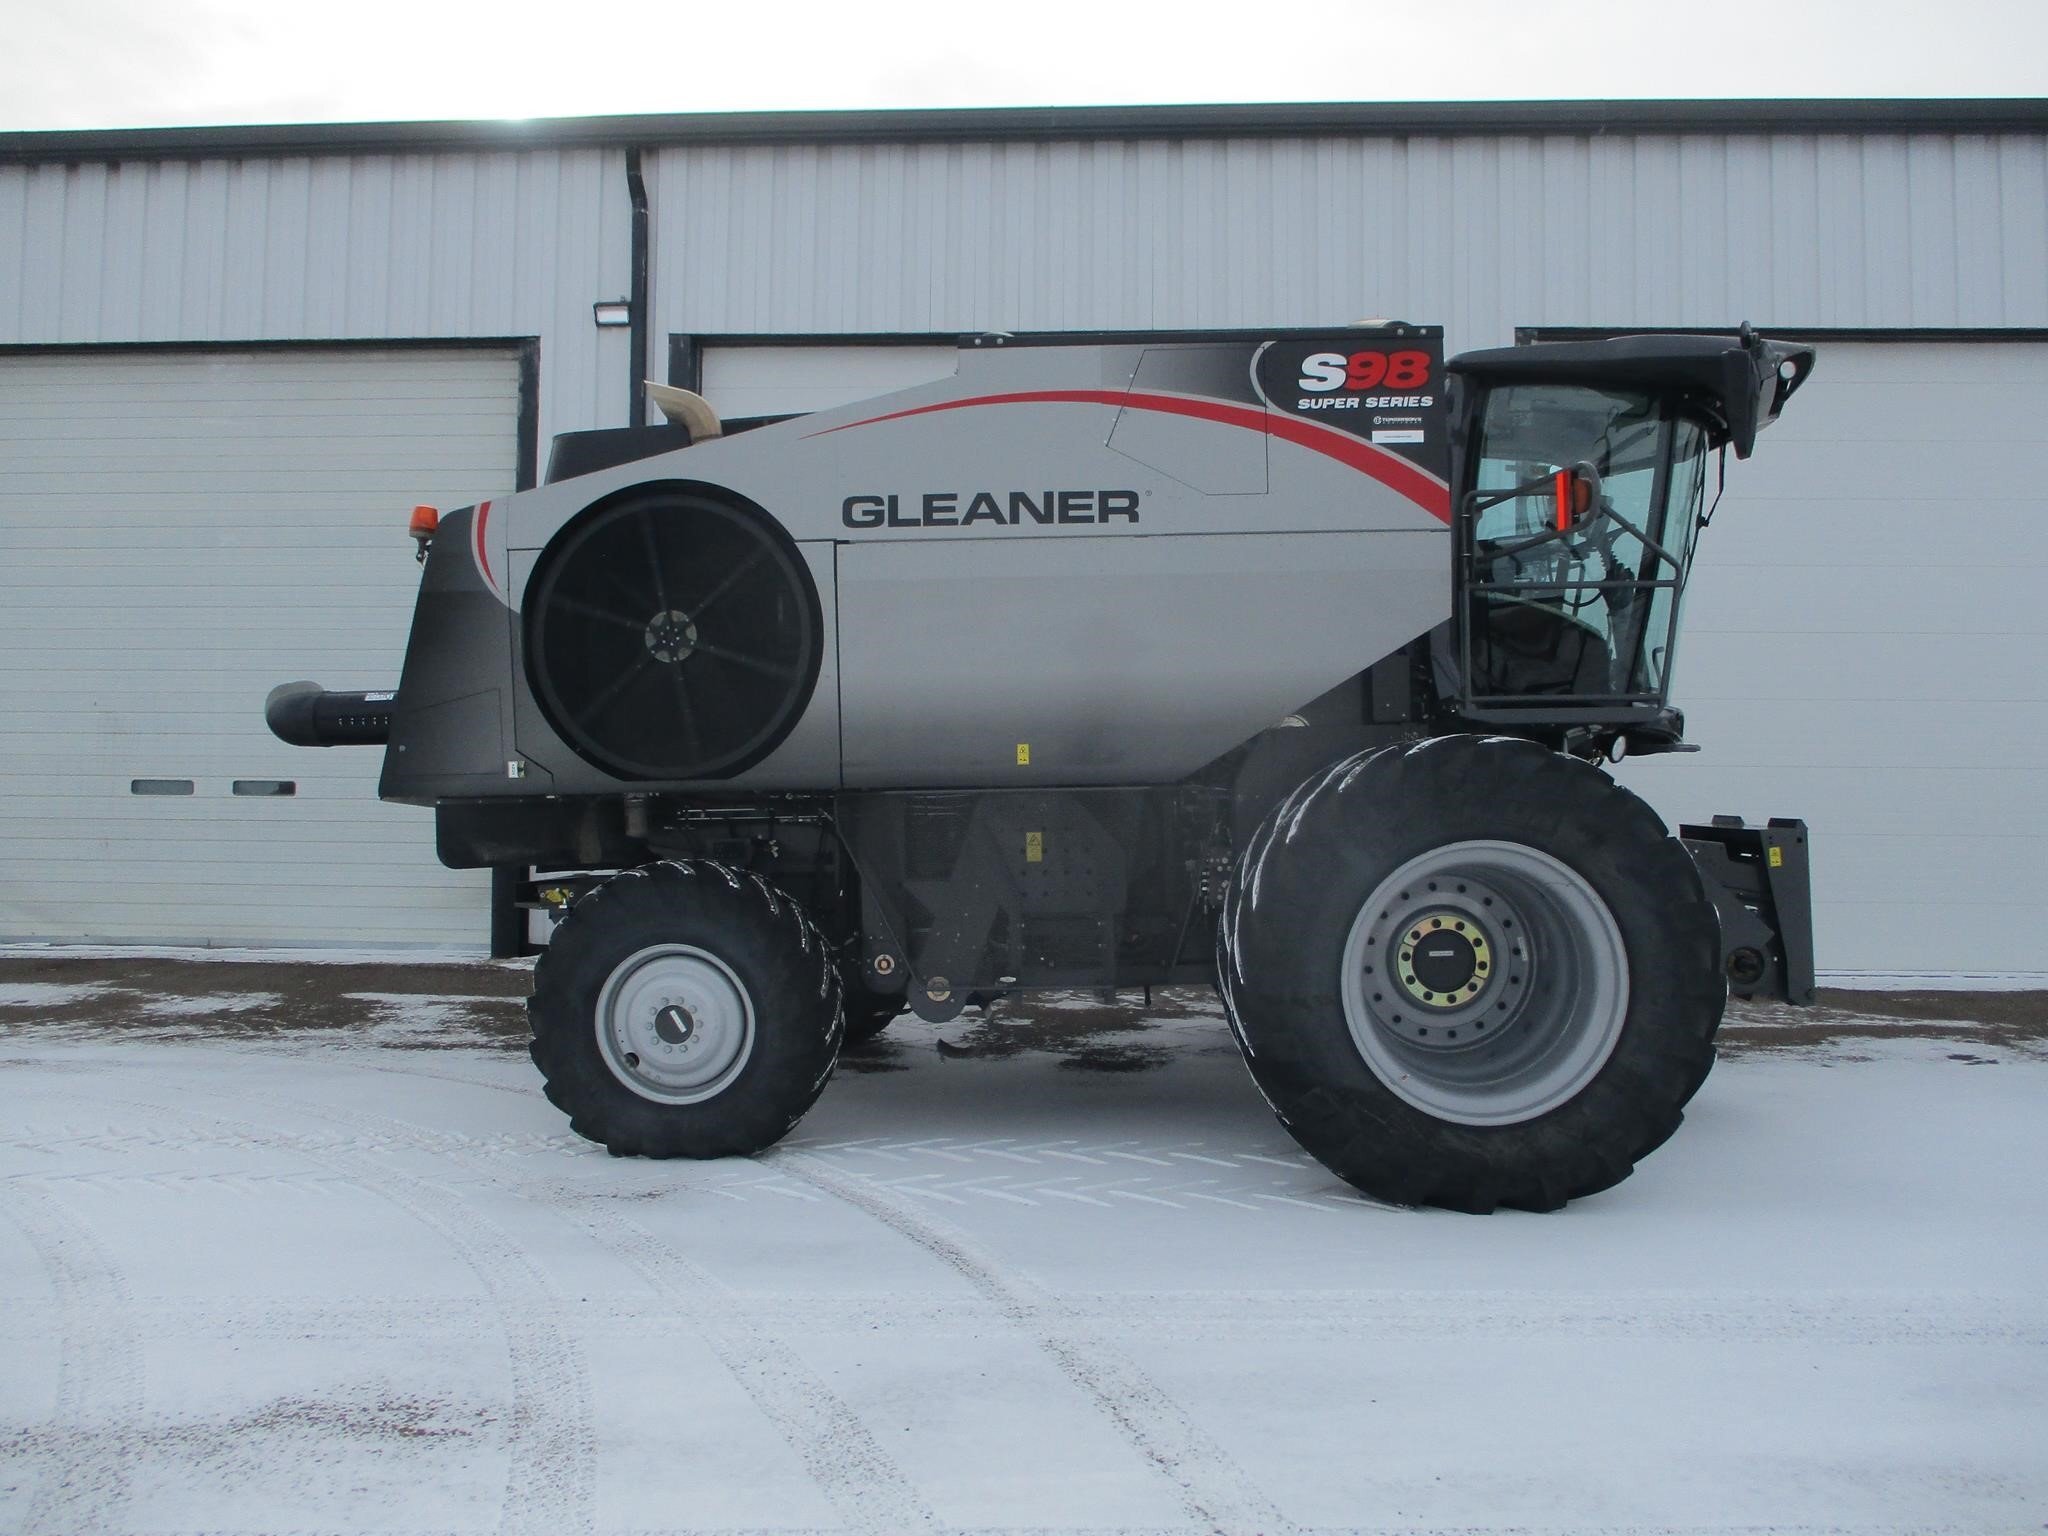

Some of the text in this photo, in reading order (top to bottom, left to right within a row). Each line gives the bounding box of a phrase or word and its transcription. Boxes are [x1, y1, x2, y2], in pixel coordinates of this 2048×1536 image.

[1298, 351, 1432, 392] S98
[1297, 395, 1434, 410] SUPER SERIES
[842, 490, 1140, 528] GLEANER
